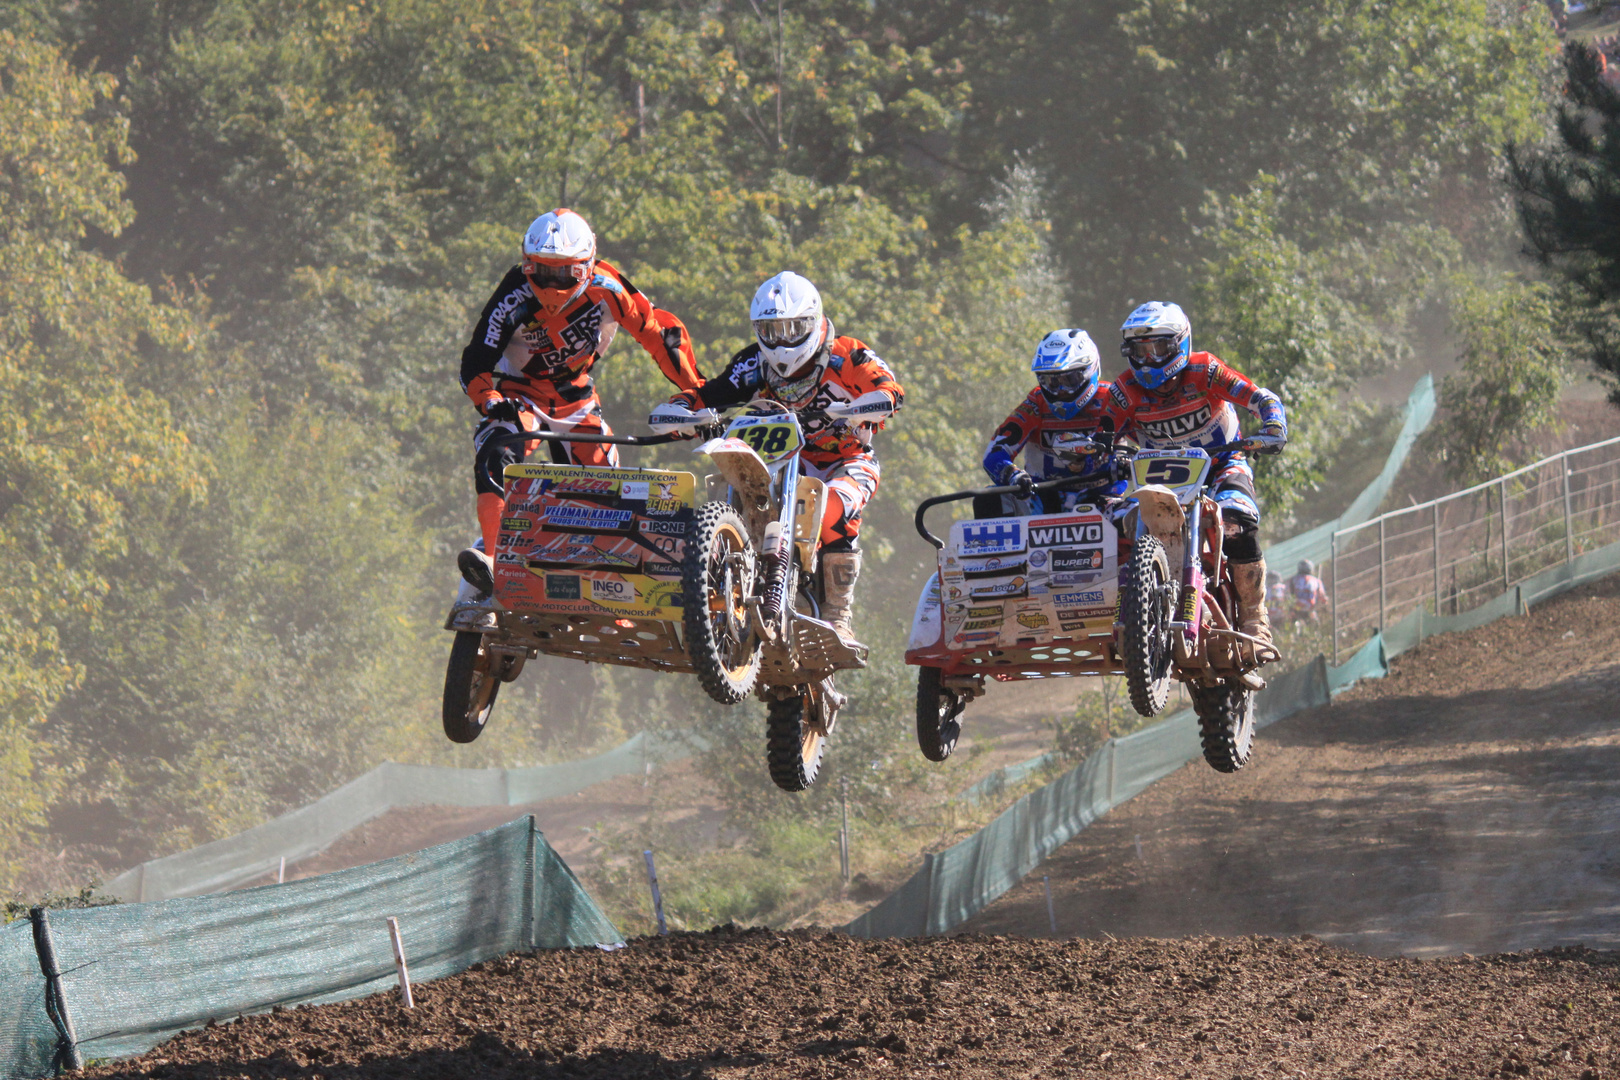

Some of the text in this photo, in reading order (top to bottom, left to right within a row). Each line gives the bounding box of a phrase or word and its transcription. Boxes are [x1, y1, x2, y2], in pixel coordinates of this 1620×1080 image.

[1165, 358, 1184, 377] WILVO
[1077, 387, 1095, 409] WILVO
[860, 403, 886, 413] IPONE
[659, 416, 685, 424] IPONE
[1140, 406, 1212, 437] WILVO
[737, 426, 791, 454] 138
[525, 468, 677, 482] WWW.VALENTIN-GIRAUD.SITEW.COM
[1145, 459, 1191, 485] 5
[646, 500, 681, 512] REIGER
[591, 509, 632, 521] KAMPEN
[649, 521, 685, 534] IPONE
[1030, 525, 1101, 545] WILVO
[1054, 558, 1090, 567] SUPER
[593, 581, 623, 593] INEO
[1054, 592, 1103, 603] LEMMENS
